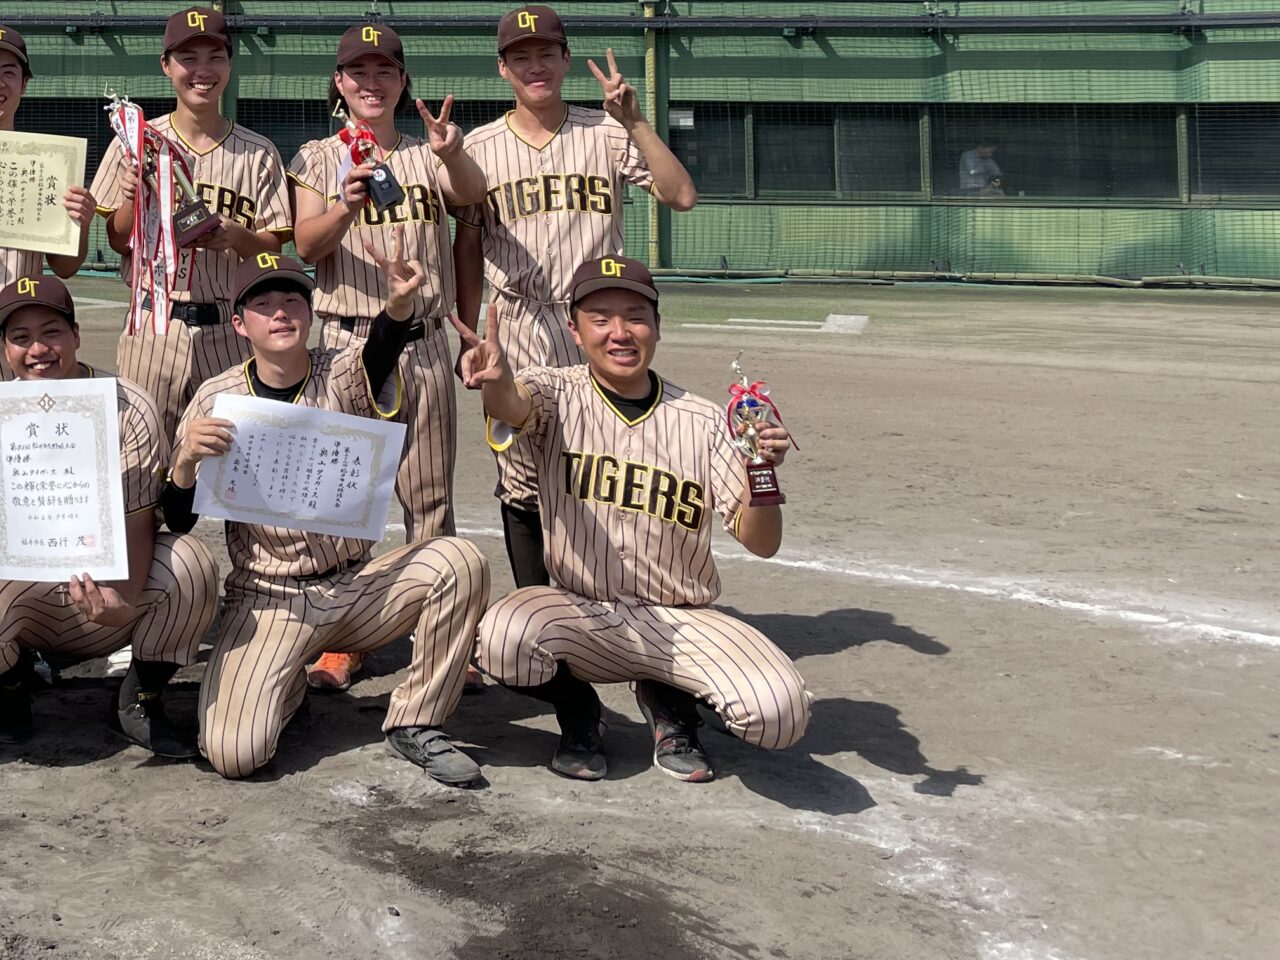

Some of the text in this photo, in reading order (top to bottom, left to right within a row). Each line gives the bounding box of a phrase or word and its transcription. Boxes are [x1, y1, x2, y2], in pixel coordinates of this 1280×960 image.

[44, 175, 59, 207] 賞状
[486, 172, 612, 227] TIGERS
[25, 422, 70, 438] 賞状
[561, 450, 705, 531] TIGERS
